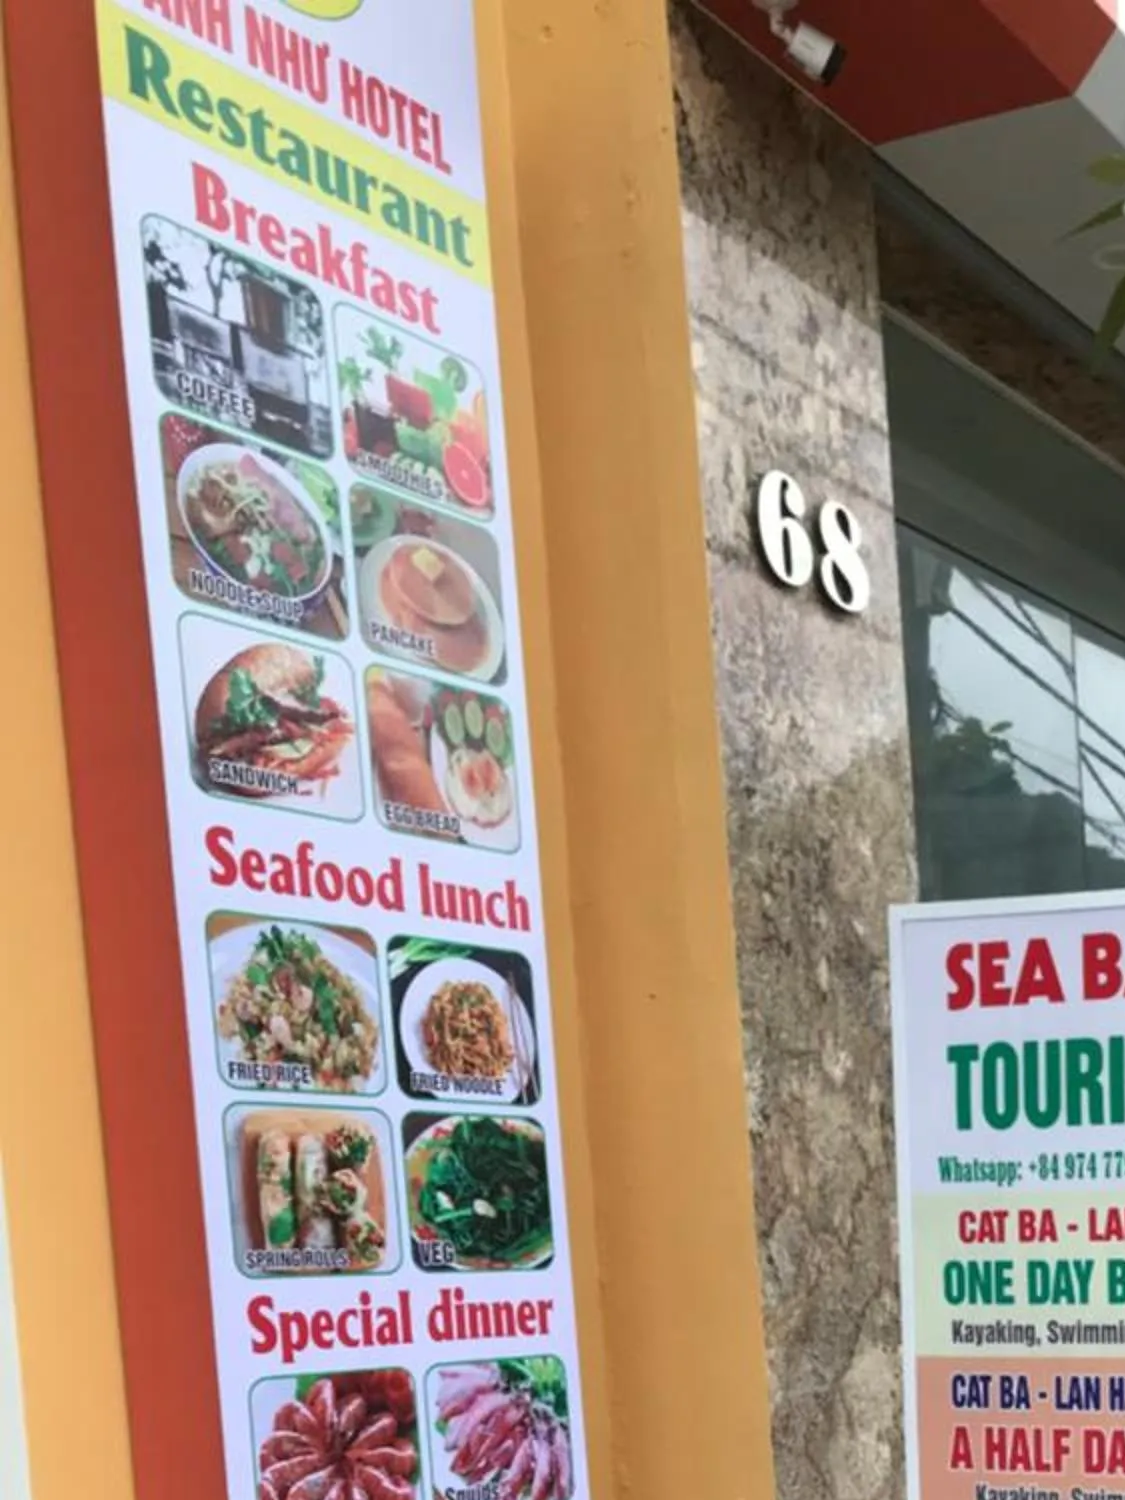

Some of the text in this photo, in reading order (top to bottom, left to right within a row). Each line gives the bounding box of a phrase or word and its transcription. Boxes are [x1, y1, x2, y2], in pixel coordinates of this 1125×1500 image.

[244, 5, 330, 103] NHƯ
[340, 59, 452, 175] HOTEL
[124, 24, 474, 267] Restaurant
[191, 161, 441, 334] Breakfast
[176, 370, 256, 421] COFFEE
[758, 470, 869, 612] 68
[371, 622, 436, 656] PANCAKE
[208, 759, 299, 795] SANDWICH
[415, 809, 461, 834] BREAD
[204, 825, 531, 932] Seafood lunch
[946, 938, 1064, 1010] SEA
[228, 1062, 312, 1084] FRIED RICE
[938, 1156, 1022, 1187] Whatsapp:
[1029, 1153, 1059, 1180] +84
[1065, 1152, 1097, 1179] 974
[959, 1210, 1009, 1243] CAT
[1018, 1209, 1058, 1242] BA
[420, 1242, 454, 1265] VEG
[943, 1260, 1015, 1306] ONE
[1027, 1259, 1095, 1305] DAY
[247, 1287, 554, 1363] Special dinner
[951, 1319, 1041, 1348] Kayaking,
[952, 1375, 992, 1408] CAT
[1000, 1375, 1031, 1409] BA
[1055, 1376, 1100, 1411] LAN
[951, 1426, 974, 1469] A
[985, 1427, 1071, 1472] HALF
